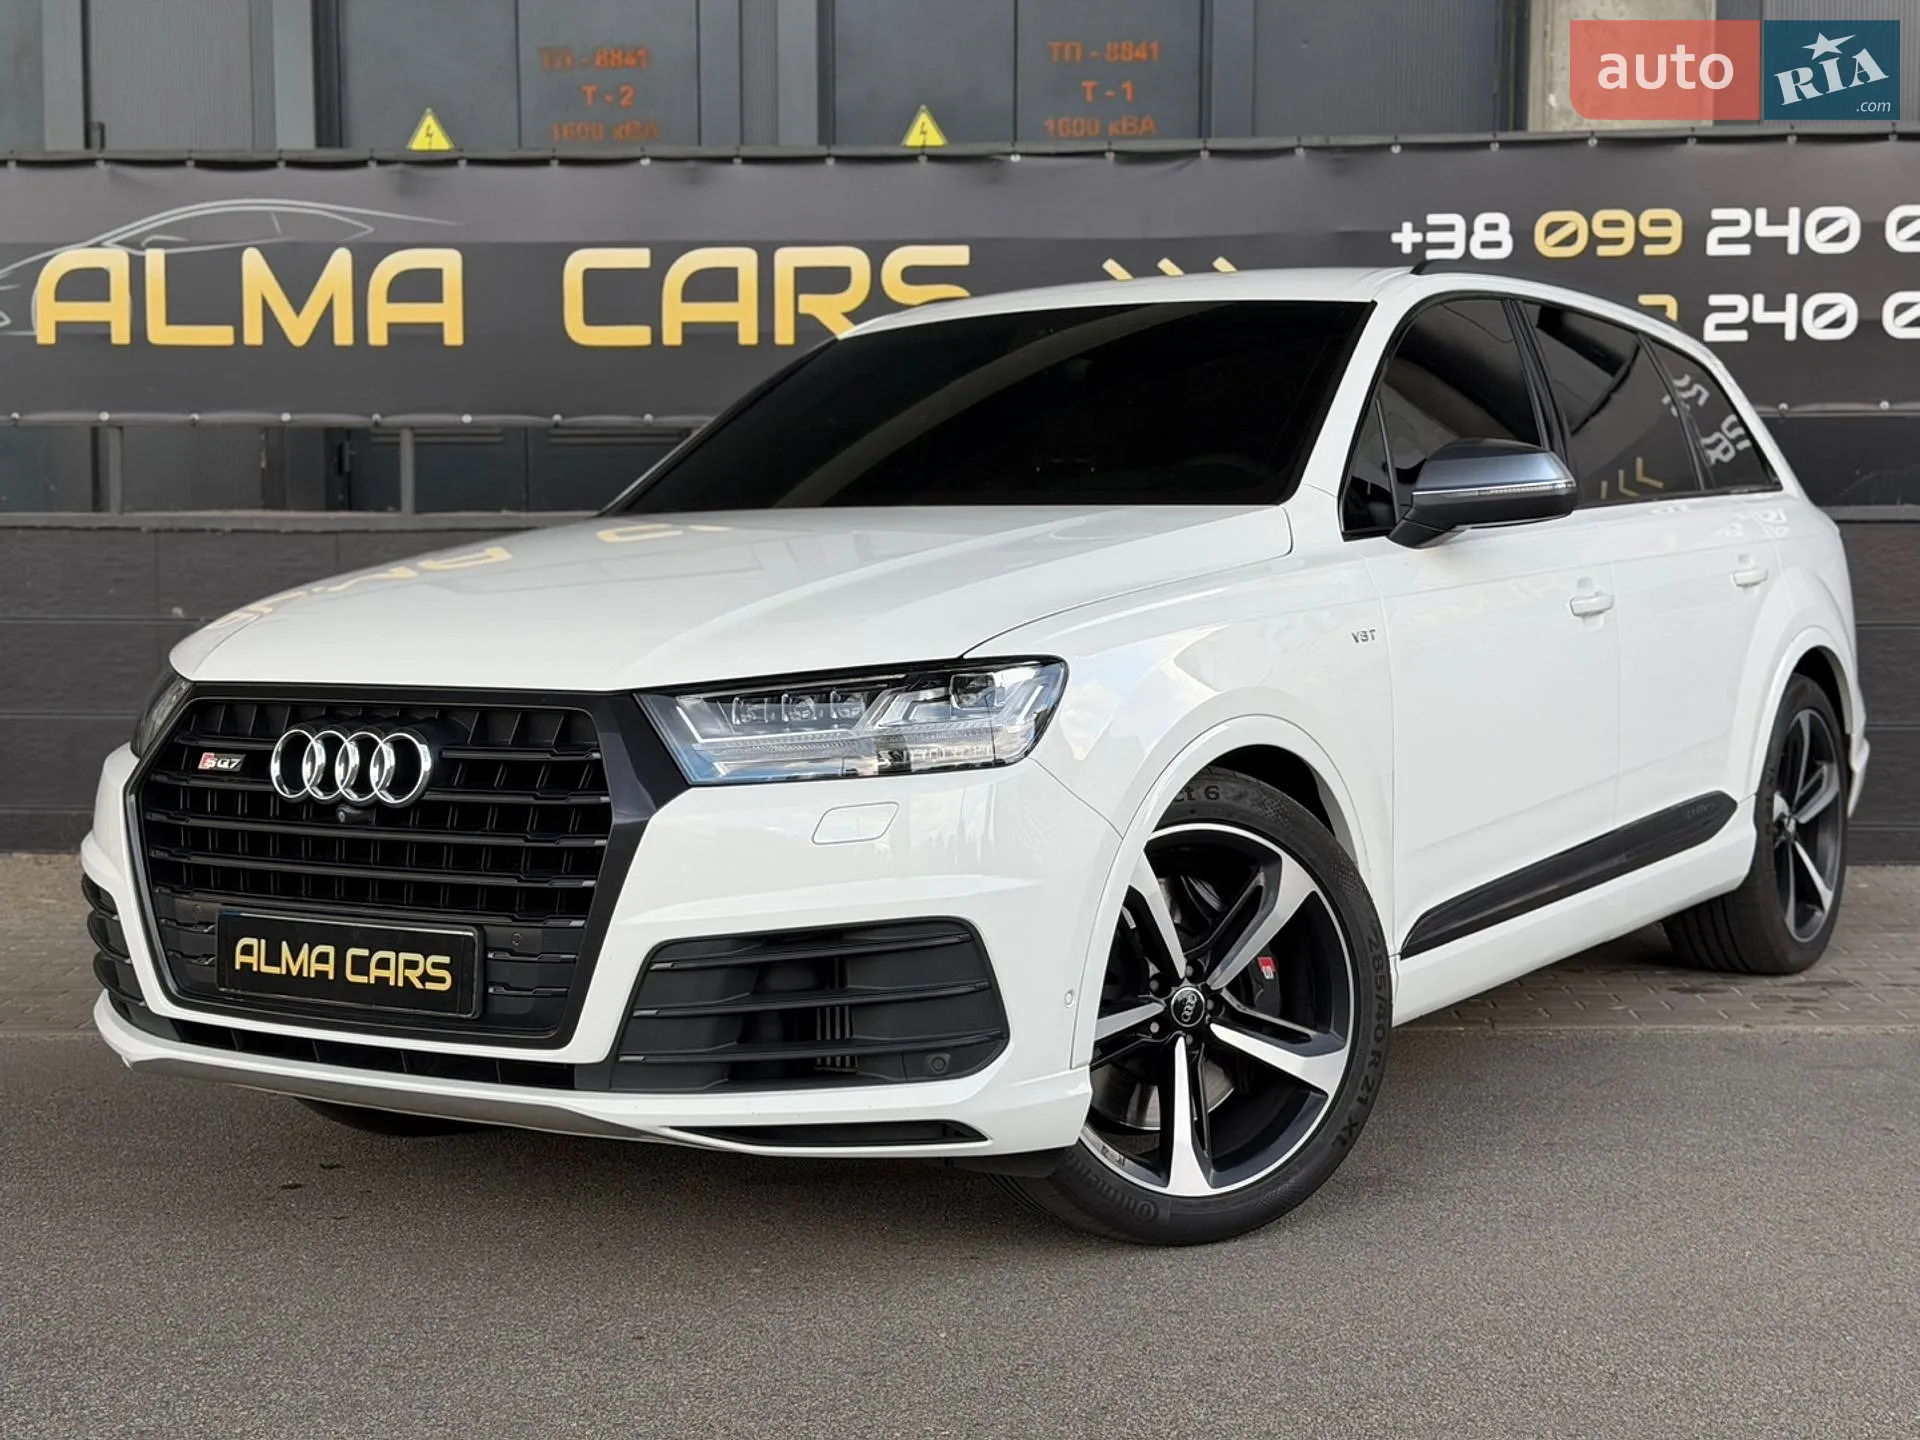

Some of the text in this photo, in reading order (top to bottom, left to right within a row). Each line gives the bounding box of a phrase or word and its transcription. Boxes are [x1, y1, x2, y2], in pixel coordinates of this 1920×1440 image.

[1105, 40, 1160, 63] 8841
[1390, 211, 1514, 260] +38
[1534, 208, 1684, 258] 099
[1706, 206, 1862, 256] 240
[36, 245, 971, 347] ALMA CARS
[1703, 292, 1859, 342] 240
[1204, 784, 1221, 801] 6
[234, 937, 452, 991] ALMA CARS
[1331, 936, 1389, 1149] 285/40 R 21 XL
